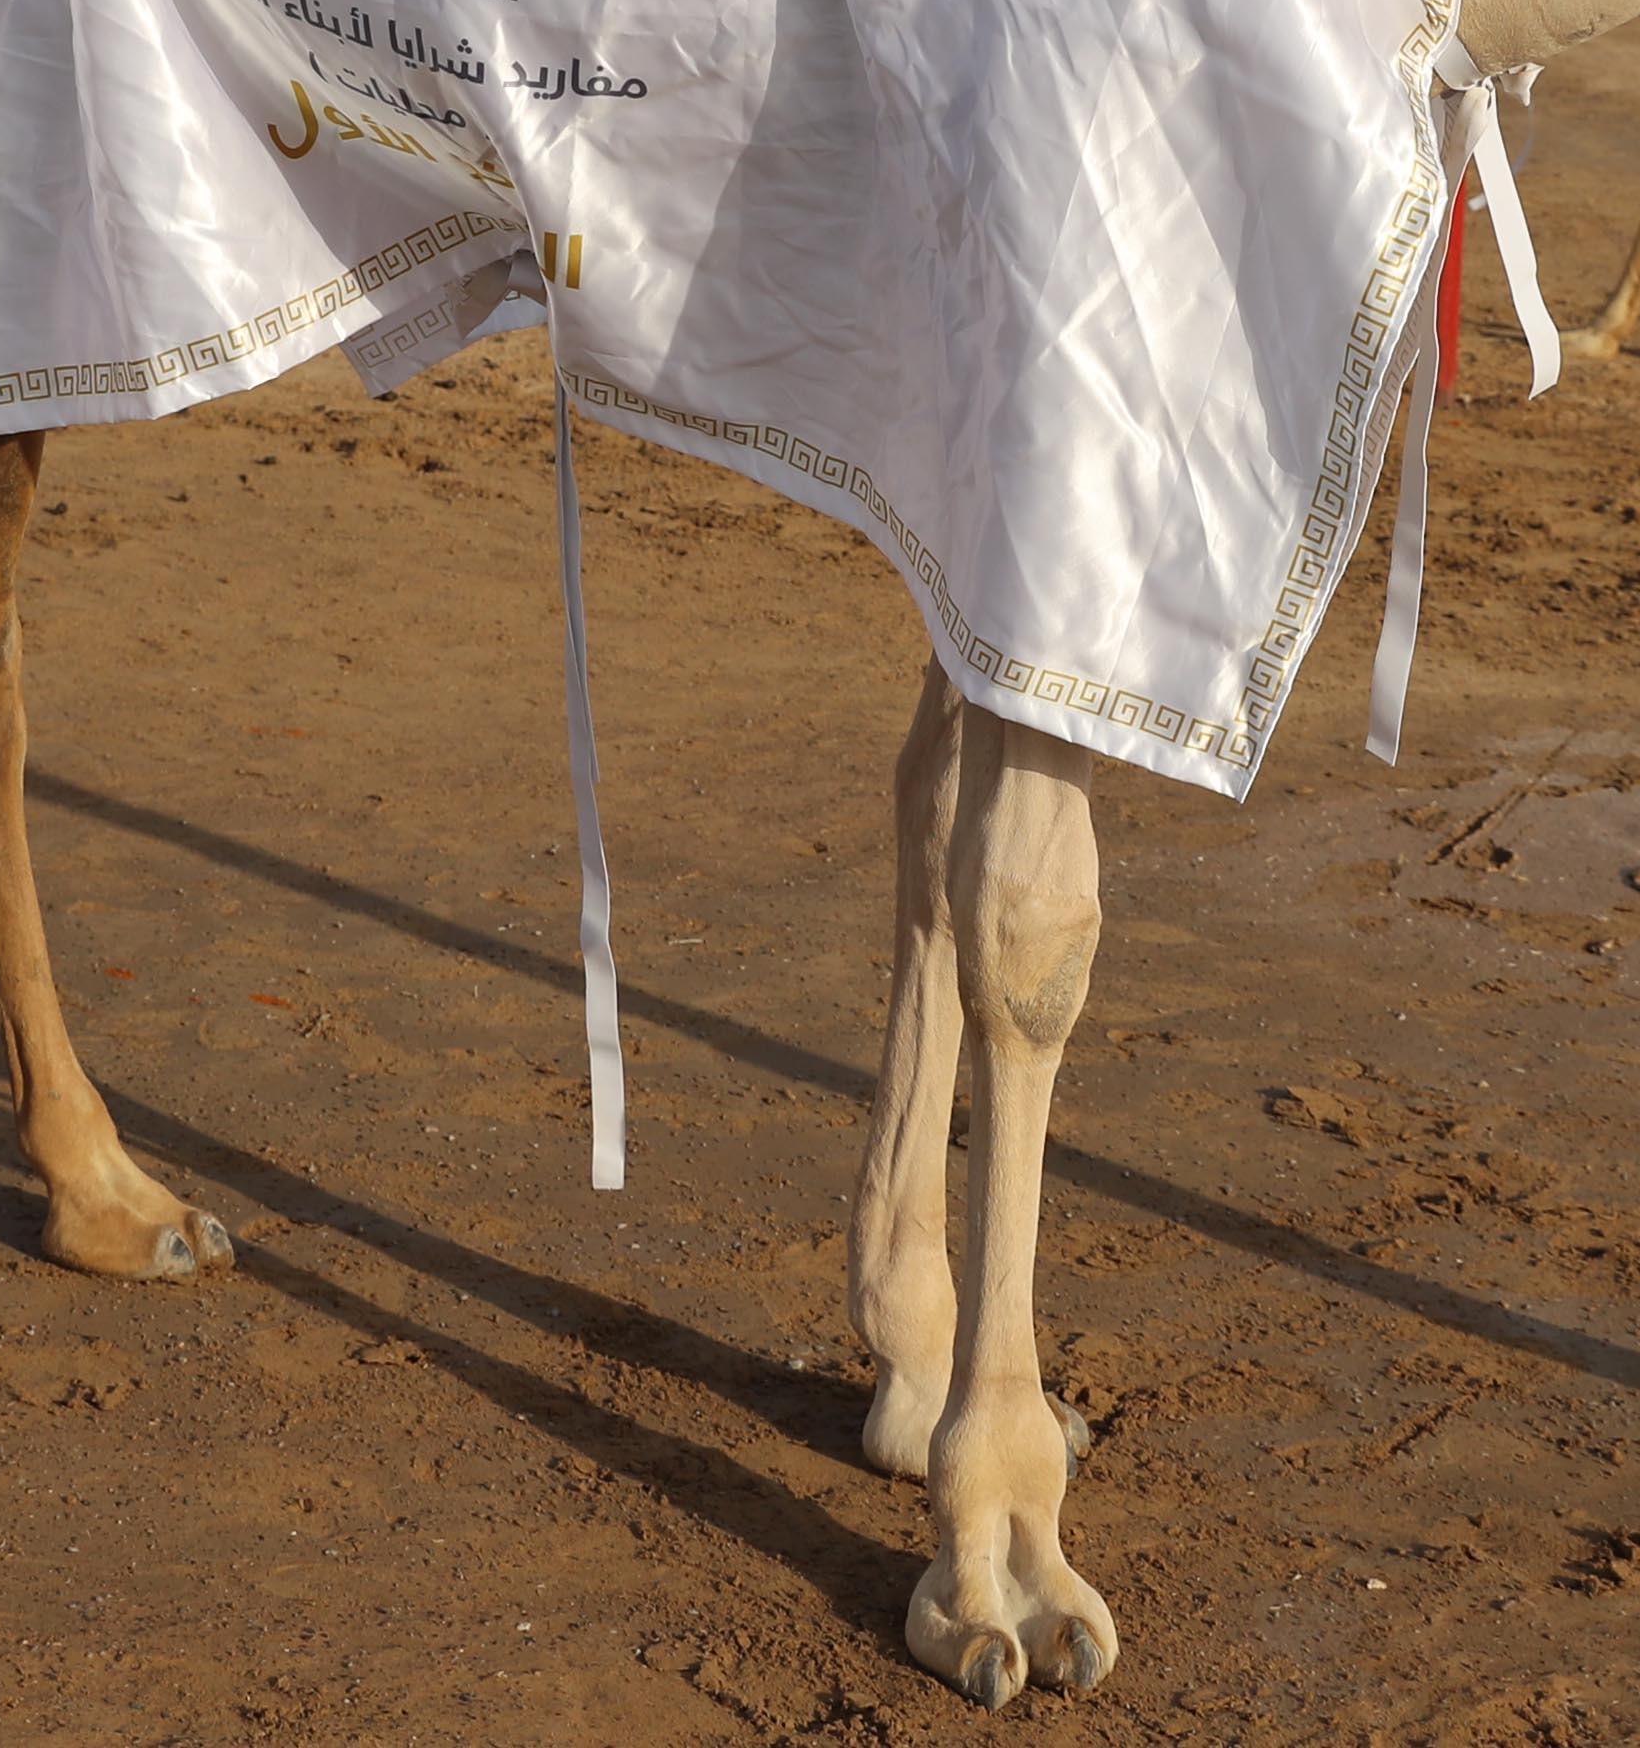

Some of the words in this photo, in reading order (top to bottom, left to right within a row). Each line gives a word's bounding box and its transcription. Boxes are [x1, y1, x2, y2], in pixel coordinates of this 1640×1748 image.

[388, 19, 485, 85] شرايا
[503, 57, 648, 100] مفاريد
[267, 79, 439, 163] الأول
